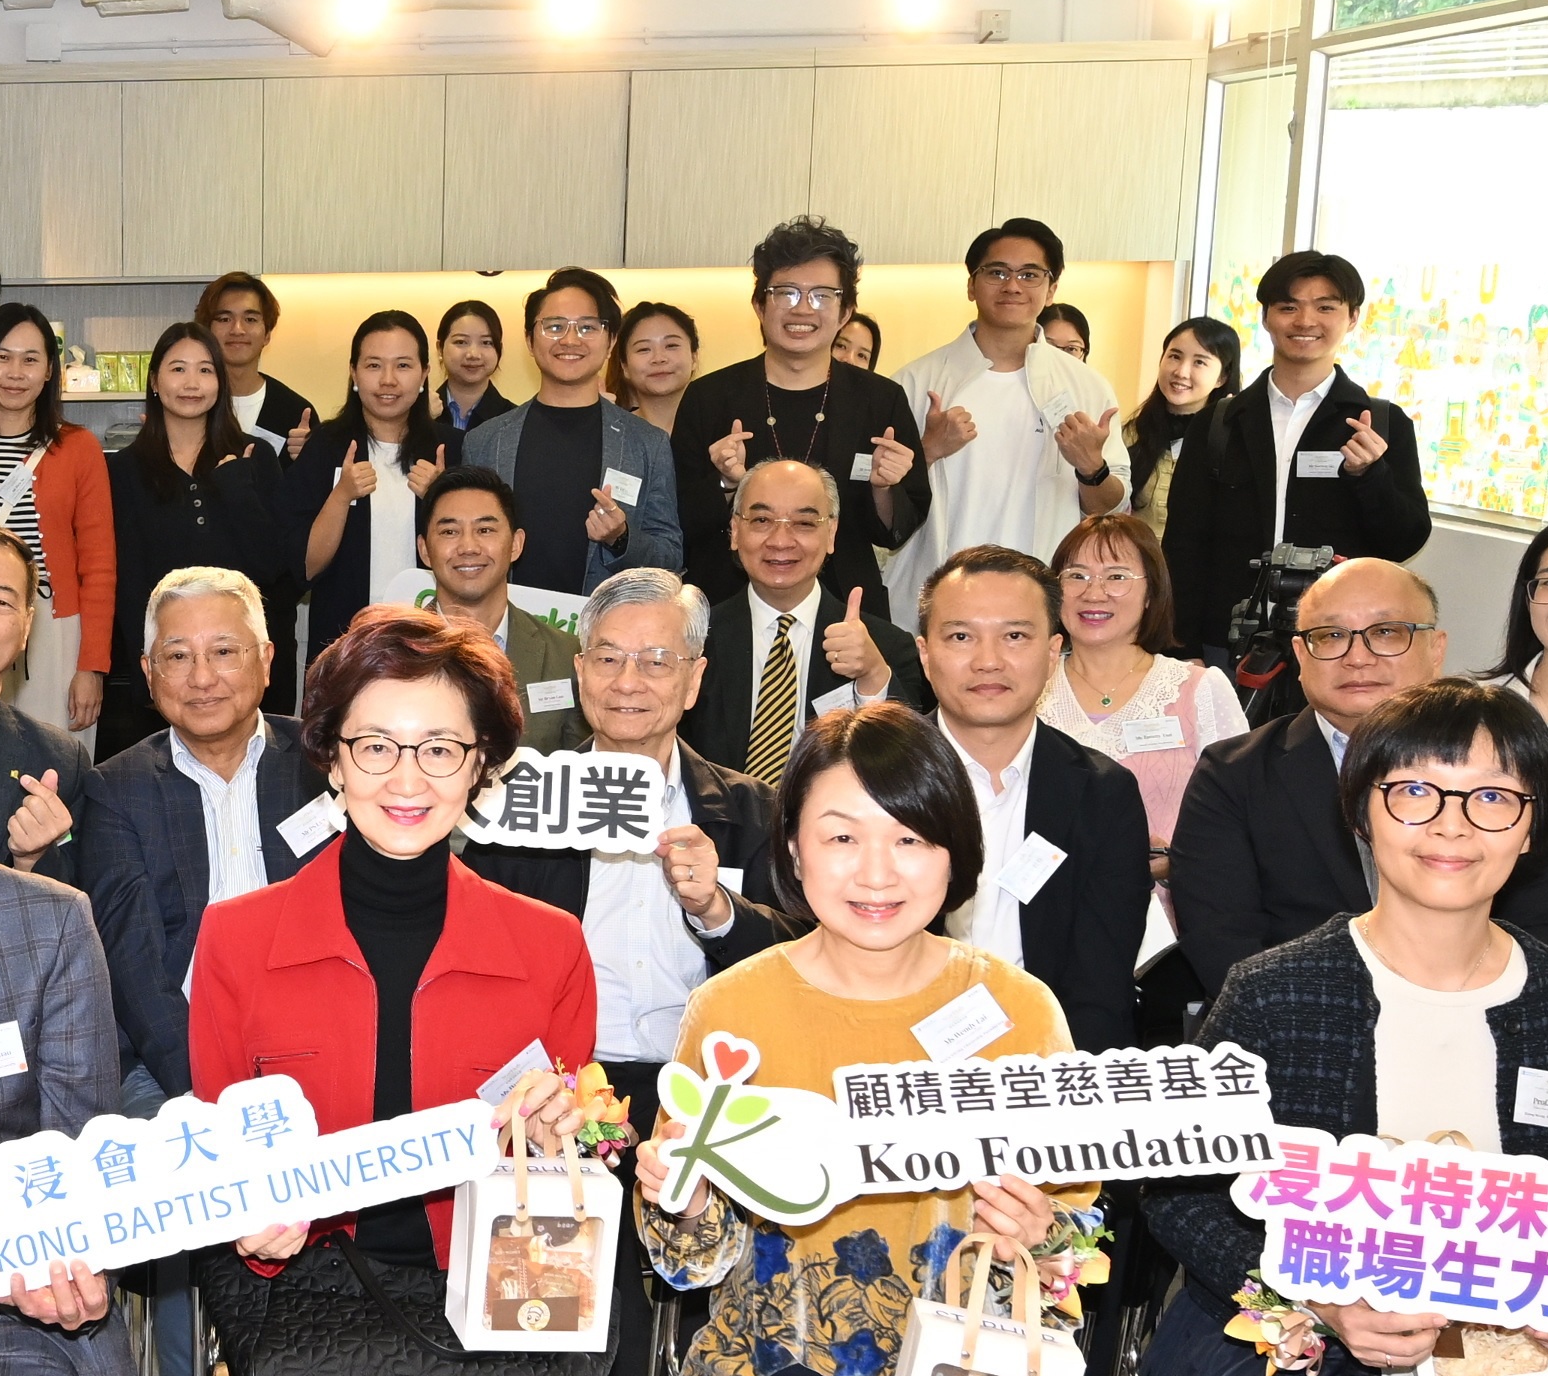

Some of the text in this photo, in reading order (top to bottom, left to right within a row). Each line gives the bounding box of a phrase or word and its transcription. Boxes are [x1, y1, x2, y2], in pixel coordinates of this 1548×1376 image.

[471, 759, 655, 840] 創業
[844, 1051, 1265, 1120] 顧積善堂慈善基金
[102, 1178, 253, 1244] BAPTIST
[267, 1122, 480, 1204] UNIVERSITY
[855, 1122, 1275, 1185] Koo Foundation
